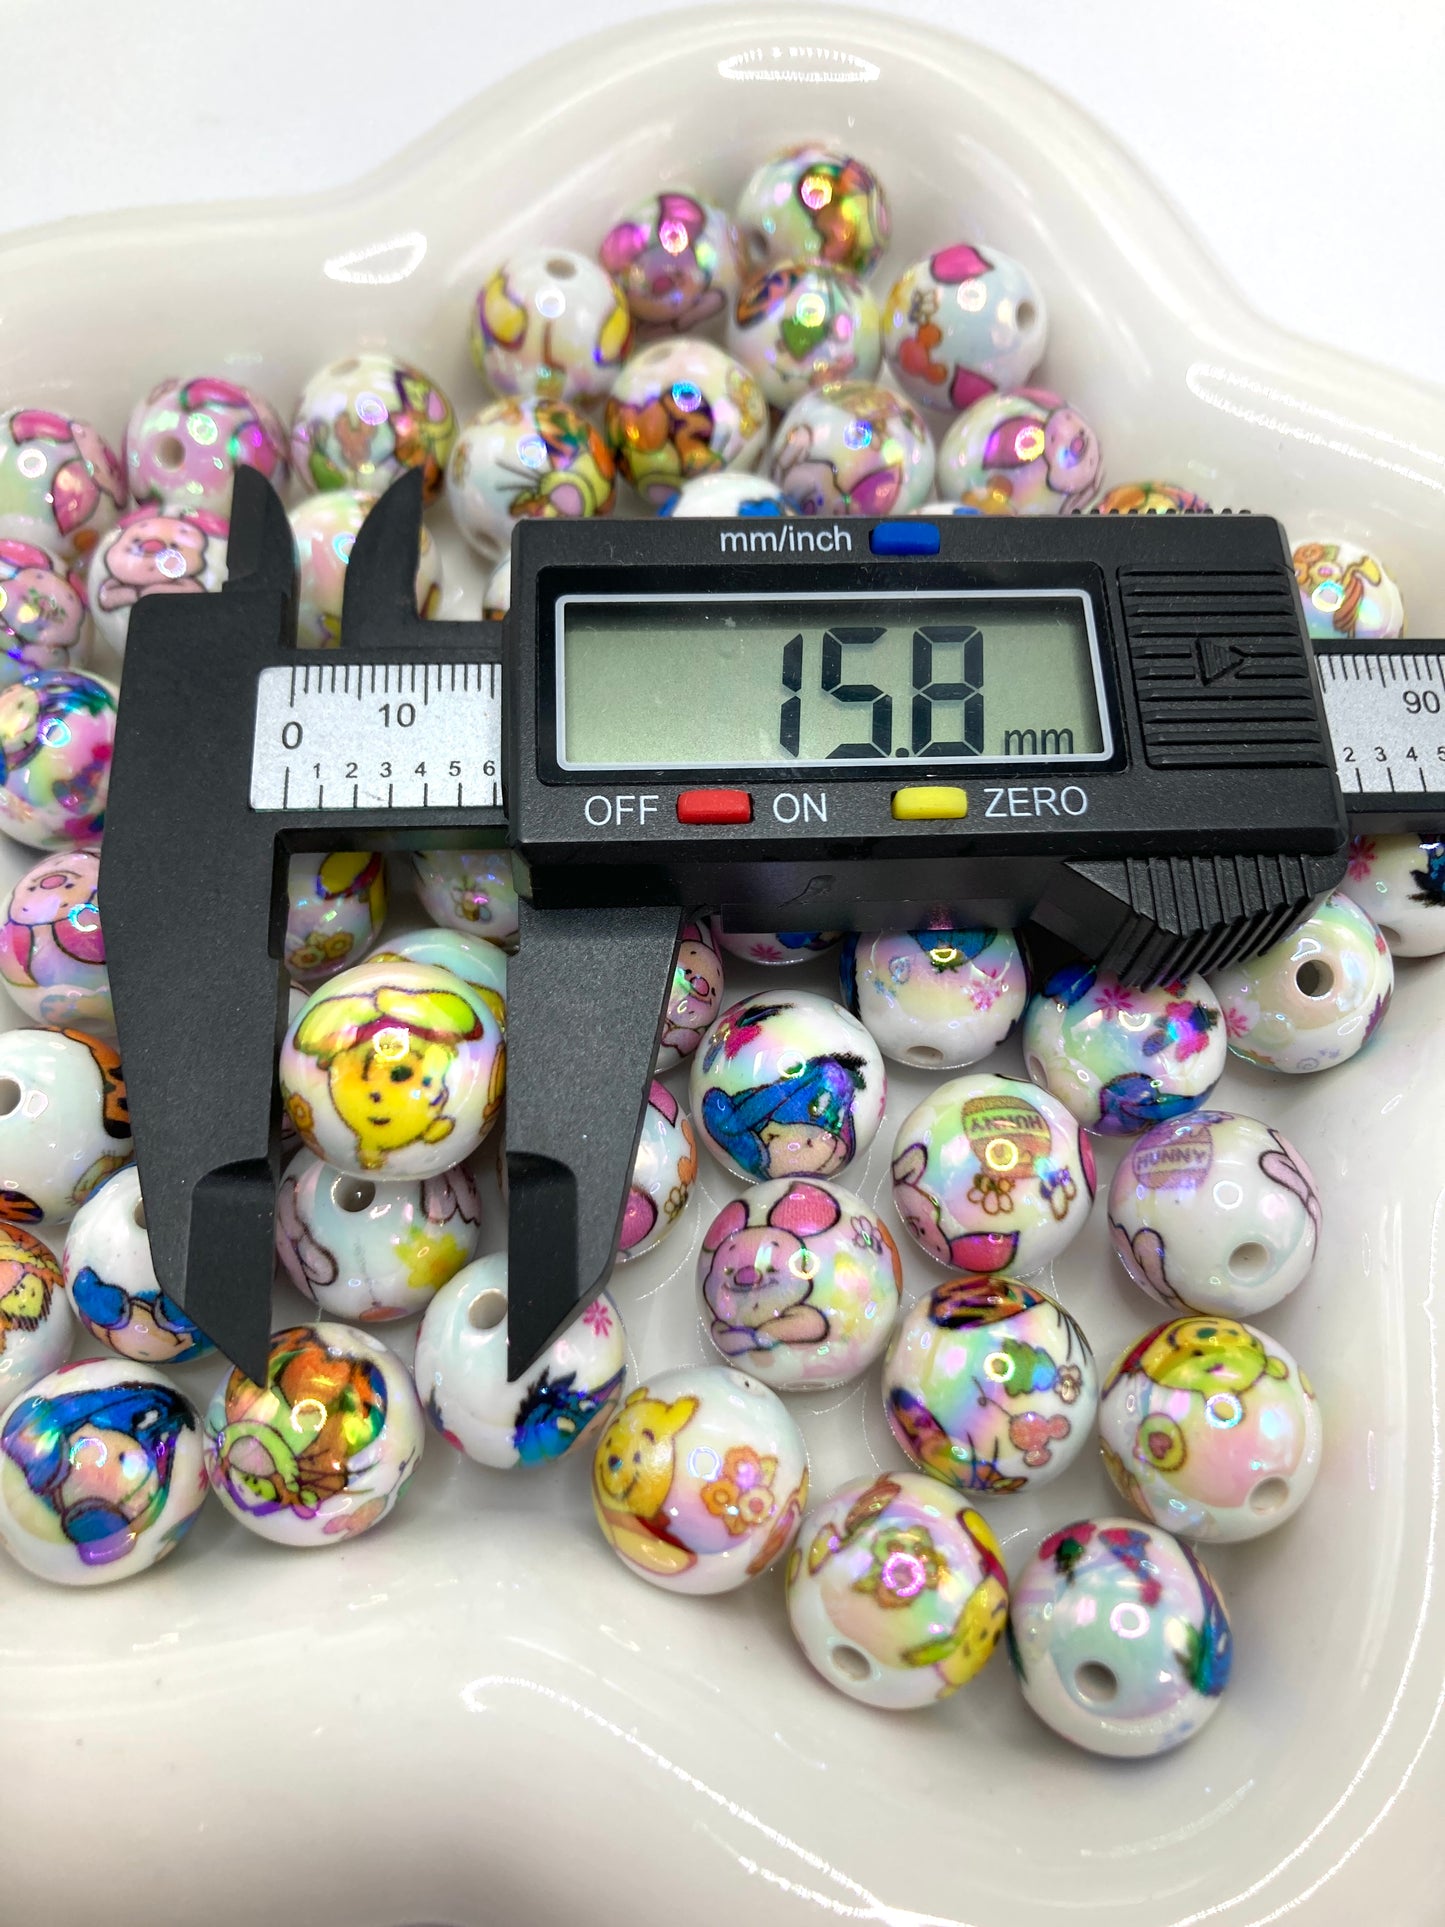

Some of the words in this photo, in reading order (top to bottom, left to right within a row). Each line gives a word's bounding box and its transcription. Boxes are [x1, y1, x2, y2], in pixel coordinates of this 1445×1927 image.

[720, 525, 852, 552] mm/inch
[779, 626, 984, 759] 15.8
[1004, 728, 1074, 755] mm
[1402, 690, 1441, 714] 90
[378, 703, 416, 727] 10
[281, 721, 303, 750] 0
[1343, 746, 1356, 762] 2
[1374, 746, 1387, 762] 3
[1406, 746, 1418, 761] 4
[313, 763, 321, 779] 1
[345, 762, 358, 778] 2
[379, 762, 393, 778] 3
[414, 761, 427, 777] 4
[449, 760, 462, 777] 5
[482, 760, 496, 776] 6
[584, 795, 659, 827] OFF
[773, 793, 827, 824] ON
[983, 785, 1088, 819] ZERO
[1136, 1147, 1207, 1171] HUNNY
